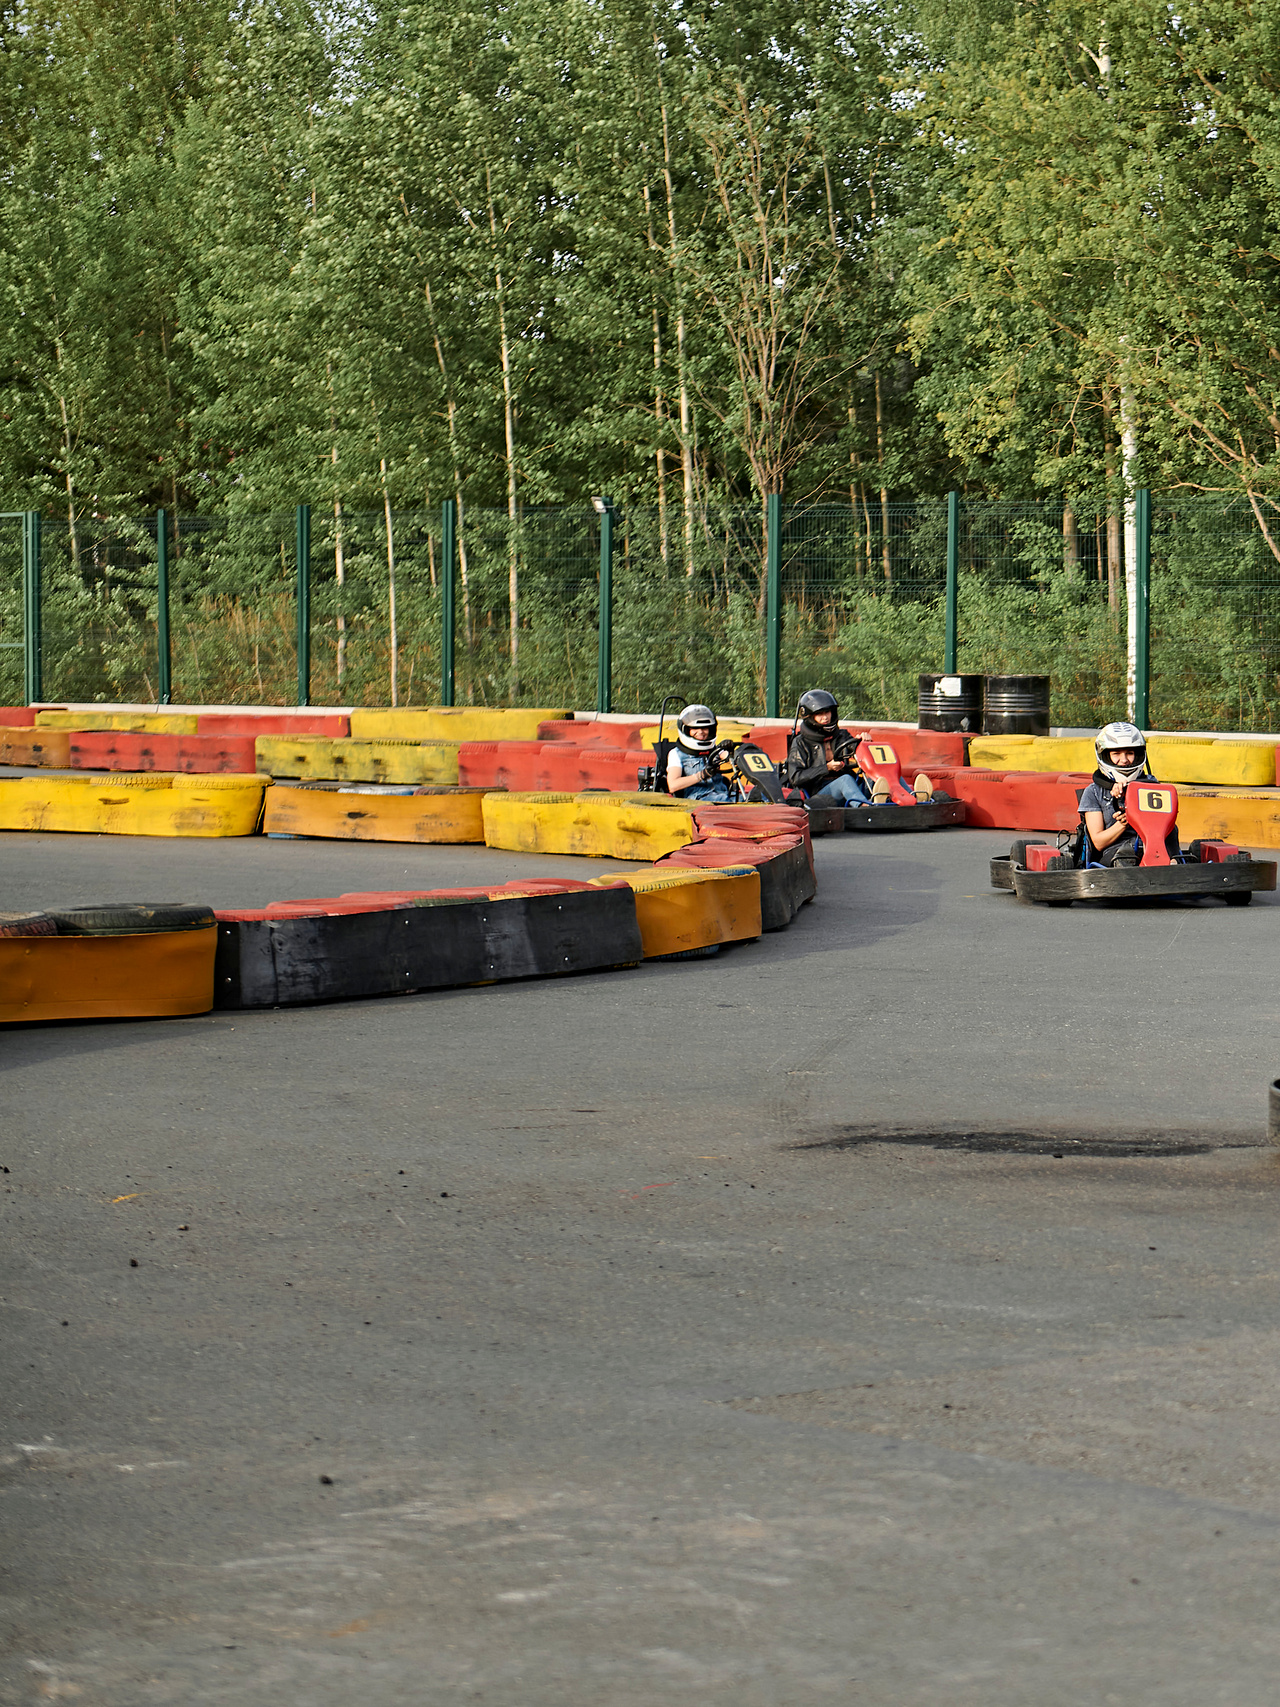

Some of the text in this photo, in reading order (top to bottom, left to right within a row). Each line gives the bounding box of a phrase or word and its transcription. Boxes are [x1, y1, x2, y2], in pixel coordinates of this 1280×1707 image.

[751, 755, 767, 769] 9
[875, 747, 888, 762] 7
[1147, 792, 1163, 809] 6
